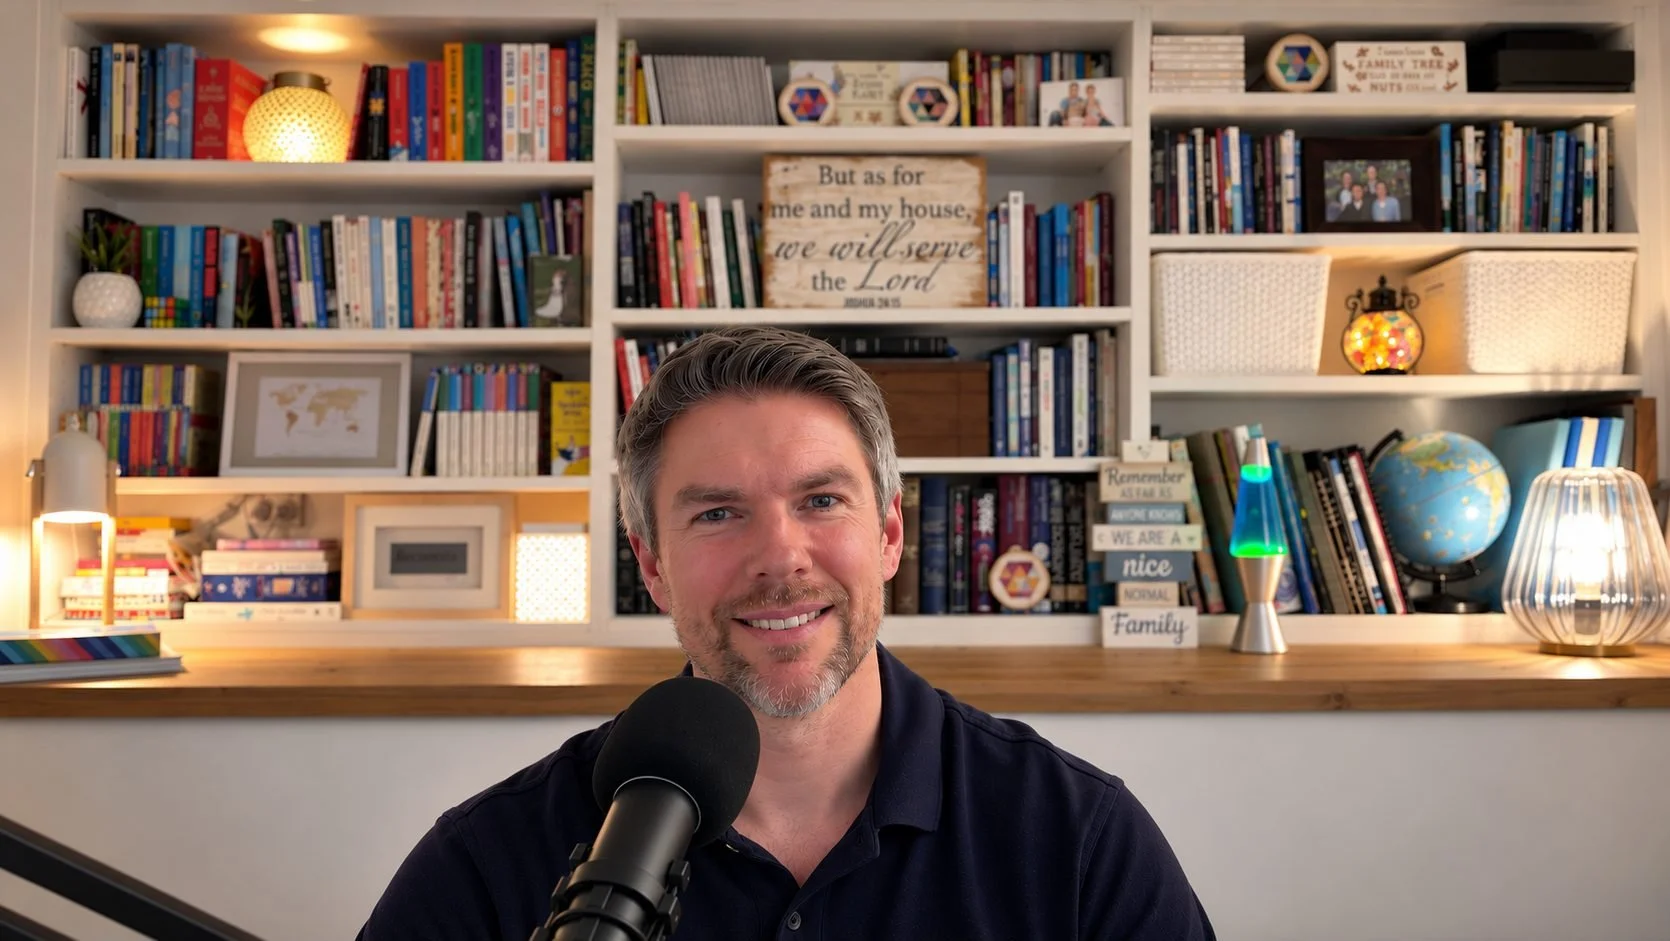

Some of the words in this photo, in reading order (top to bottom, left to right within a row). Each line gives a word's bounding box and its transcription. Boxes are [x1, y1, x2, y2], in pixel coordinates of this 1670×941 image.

[1358, 60, 1404, 70] FAMILY
[1412, 60, 1444, 70] TREE
[1370, 83, 1402, 93] NUTS
[819, 165, 855, 186] But
[863, 171, 886, 186] as
[893, 165, 925, 186] for
[771, 203, 804, 219] me
[810, 198, 851, 219] and
[859, 204, 893, 224] my
[900, 198, 972, 222] house,
[774, 241, 817, 260] we
[829, 219, 916, 260] will
[900, 241, 975, 260] serve
[812, 270, 847, 292] the
[854, 257, 947, 293] Lord
[1105, 466, 1185, 487] Remember
[1111, 530, 1134, 546] WE
[1138, 530, 1165, 546] ARE
[1171, 530, 1181, 546] A
[1122, 553, 1173, 577] nice
[1124, 588, 1171, 602] NORMAL
[1110, 611, 1190, 645] Family
